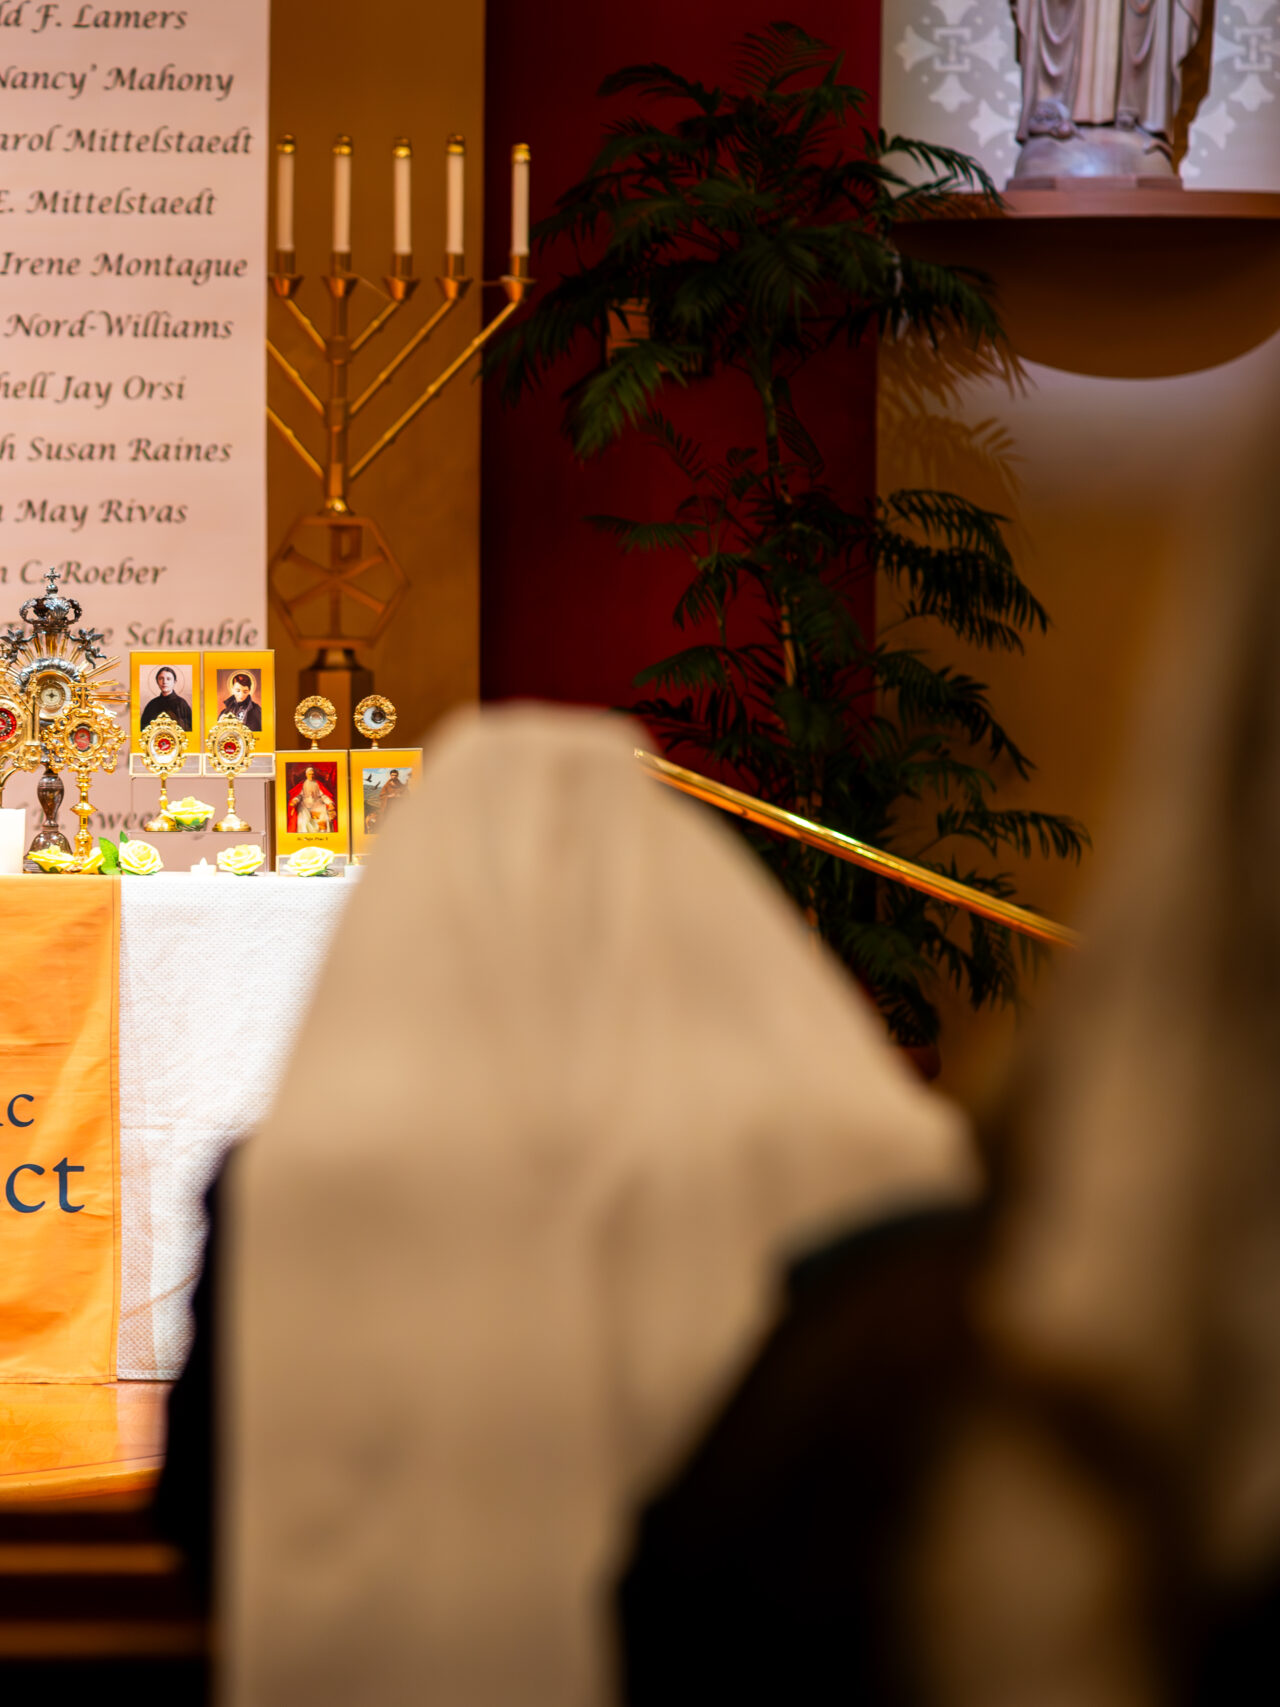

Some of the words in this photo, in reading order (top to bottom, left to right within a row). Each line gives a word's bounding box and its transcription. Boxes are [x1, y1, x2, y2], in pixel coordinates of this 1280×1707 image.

[31, 3, 63, 34] F.
[71, 4, 188, 30] Lamers
[103, 63, 235, 101] Mahony
[63, 125, 254, 155] Mittelstaedt
[25, 187, 217, 216] Mittelstaedt
[89, 252, 249, 286] Montague
[3, 310, 234, 339] Nord-Williams
[54, 374, 113, 409] Jay
[122, 375, 187, 401] Orsi
[26, 436, 117, 462] Susan
[127, 437, 233, 463] Raines
[13, 498, 89, 533] May
[98, 498, 189, 525] Rivas
[60, 557, 168, 586] Roeber
[124, 617, 259, 647] Schauble
